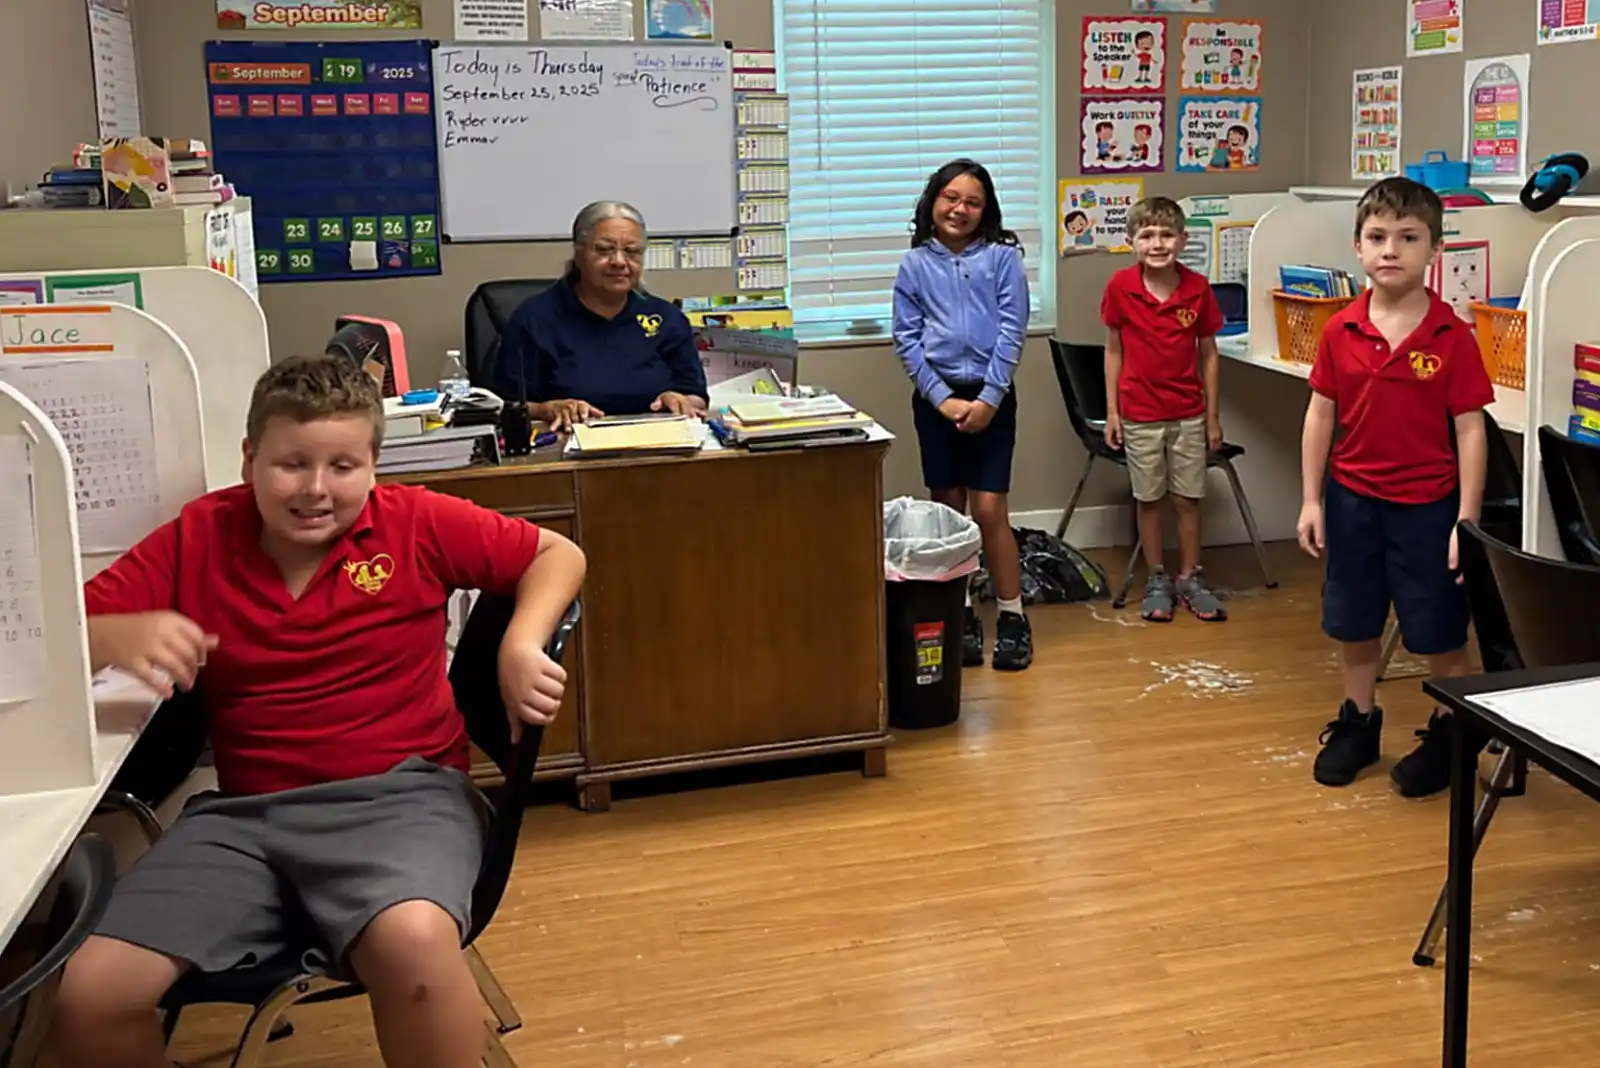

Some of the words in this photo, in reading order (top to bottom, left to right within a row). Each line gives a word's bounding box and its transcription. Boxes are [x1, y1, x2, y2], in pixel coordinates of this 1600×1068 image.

[254, 3, 389, 28] September
[1092, 32, 1132, 43] LISTEN
[1189, 37, 1253, 47] RESPONSIBLE
[1093, 53, 1131, 61] Speaker
[233, 67, 303, 80] September
[340, 64, 355, 77] 19
[383, 68, 413, 79] 2025
[440, 50, 499, 85] Today
[505, 60, 521, 74] is
[528, 50, 603, 85] Thursday
[443, 85, 525, 104] September
[559, 83, 599, 97] 2025
[1091, 111, 1115, 120] Work
[1117, 111, 1156, 120] QUIETLY
[1188, 110, 1212, 118] TAKE
[1216, 110, 1239, 118] CARE
[445, 111, 486, 131] Ryder
[1203, 121, 1224, 130] your
[1188, 131, 1216, 140] things
[1100, 196, 1131, 205] RAISE
[1105, 208, 1126, 216] your
[287, 224, 306, 237] 23
[321, 223, 341, 237] 24
[355, 222, 373, 235] 25
[384, 221, 402, 235] 26
[416, 221, 432, 234] 27
[1096, 226, 1105, 234] to
[259, 255, 277, 267] 29
[291, 254, 311, 267] 30
[9, 314, 81, 345] Jace
